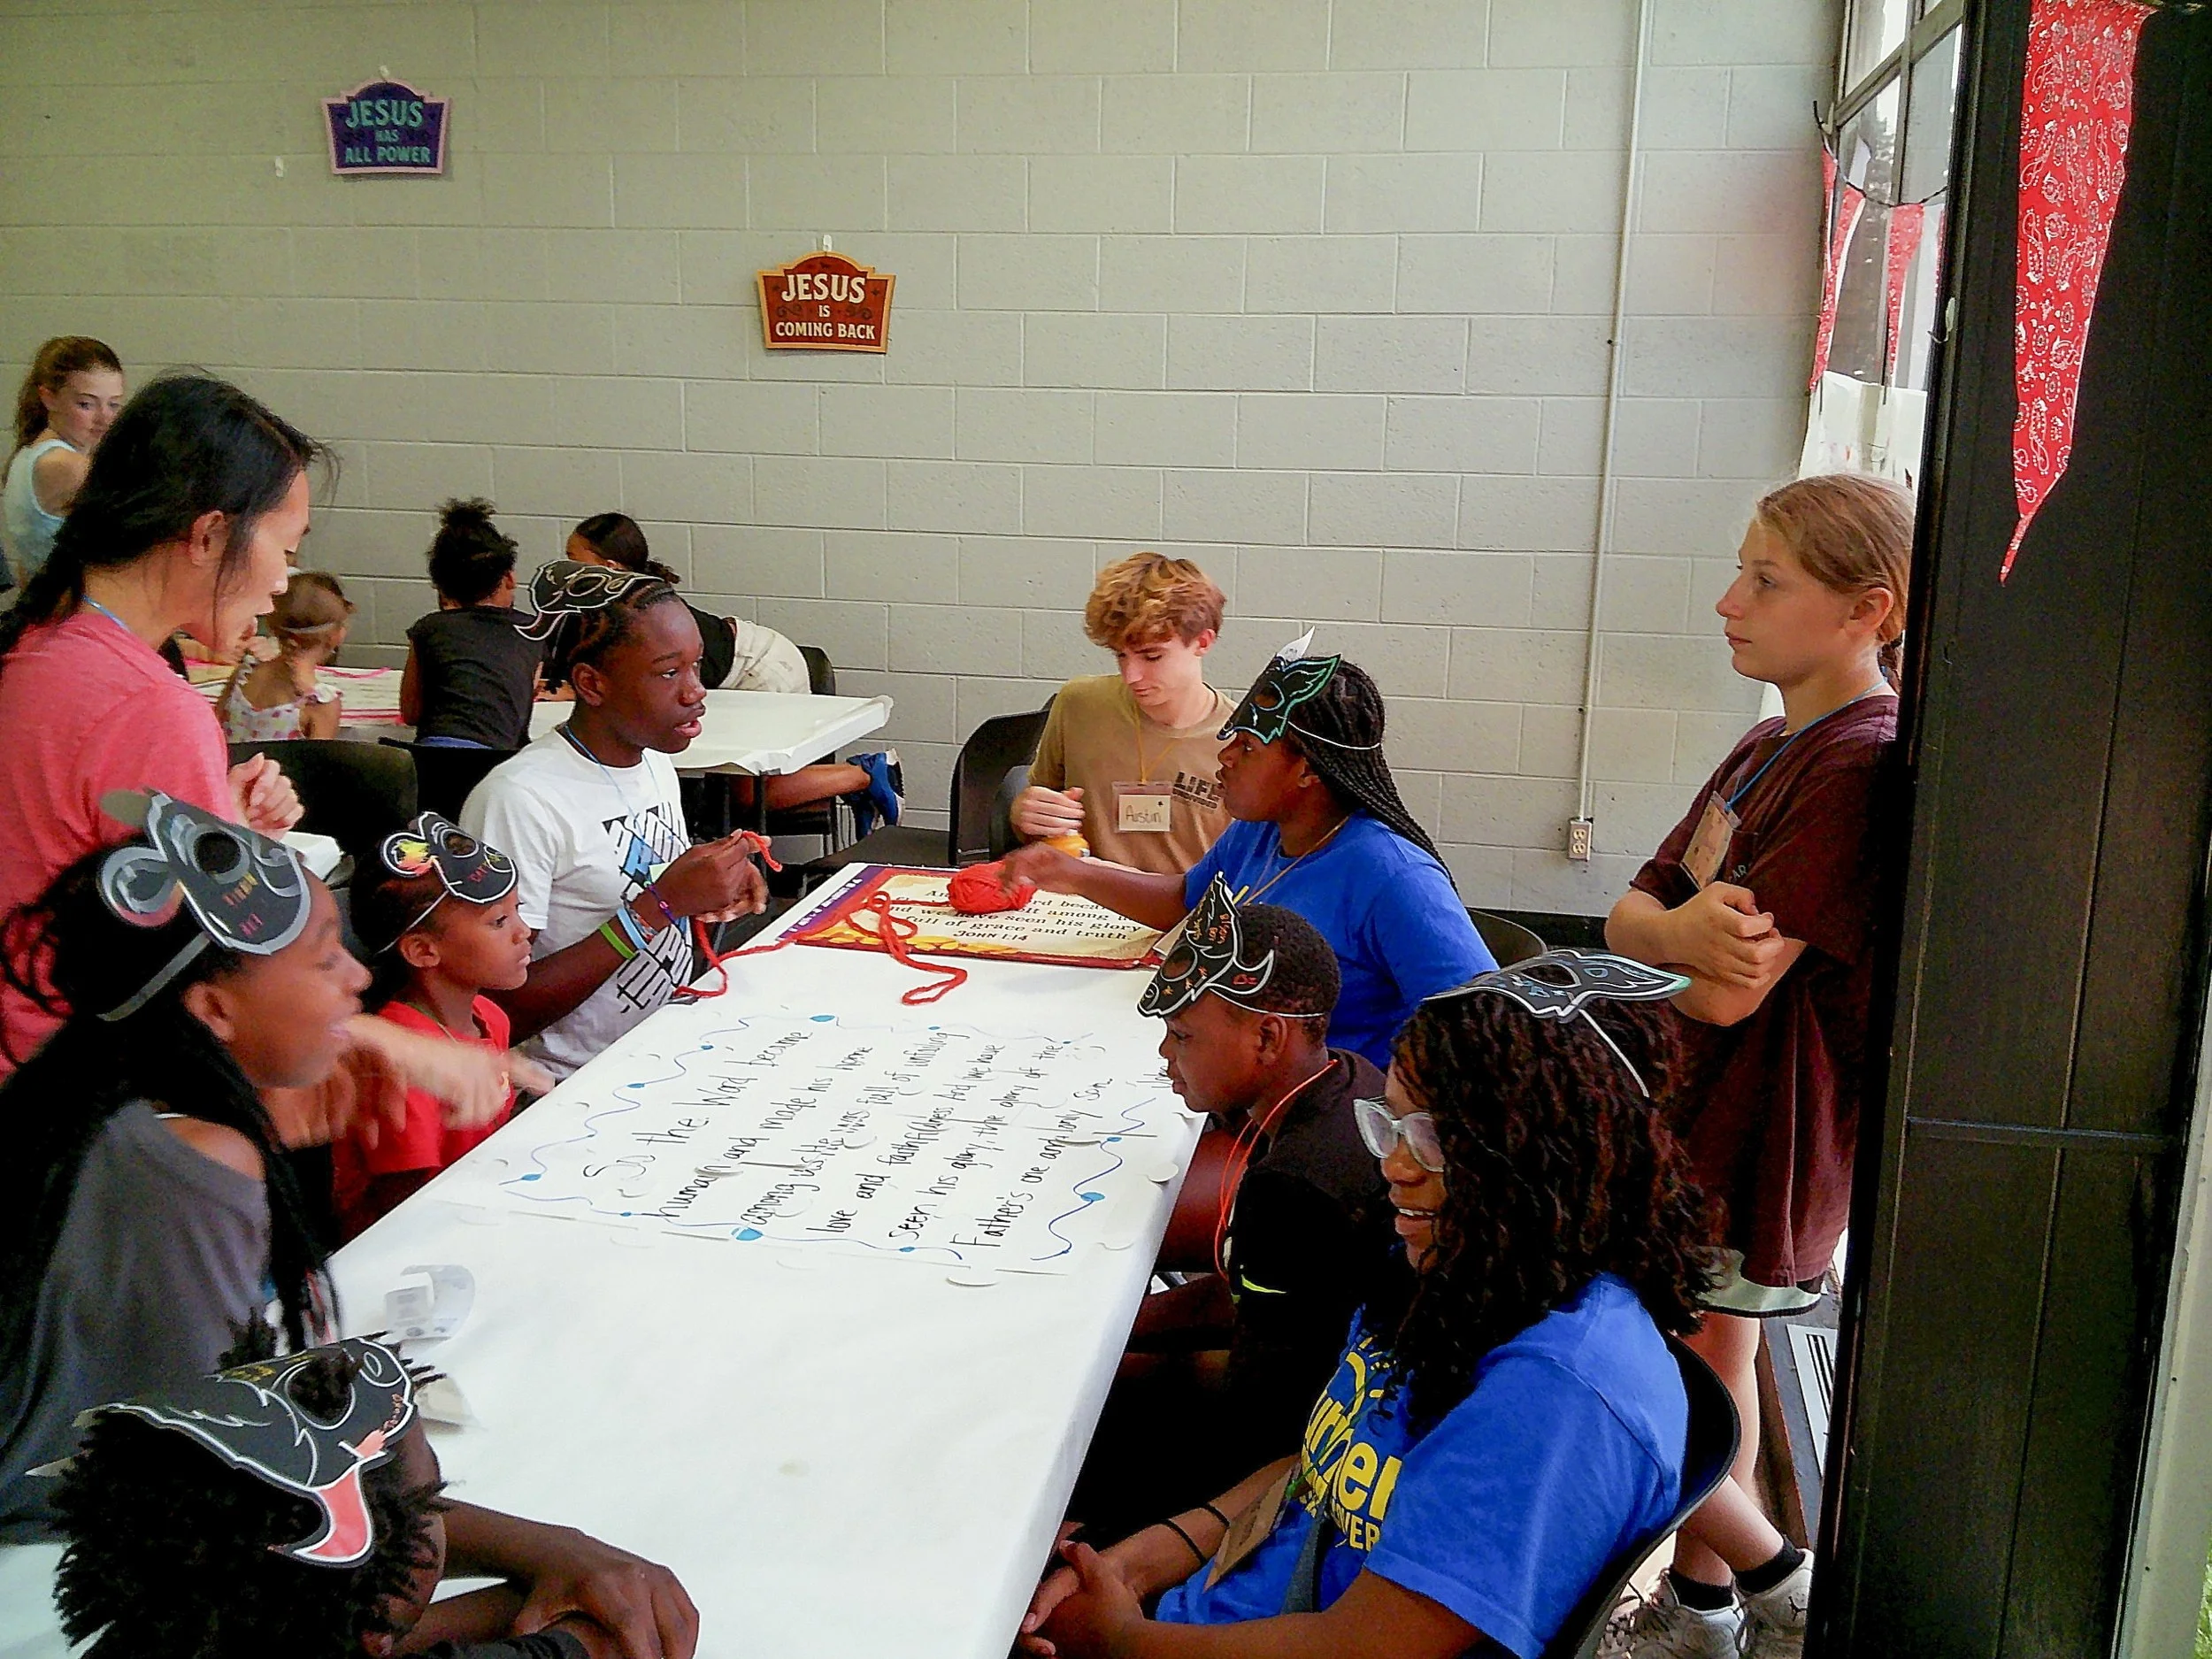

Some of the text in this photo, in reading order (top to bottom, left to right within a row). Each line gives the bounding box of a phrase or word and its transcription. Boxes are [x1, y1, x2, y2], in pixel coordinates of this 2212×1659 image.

[345, 99, 424, 128] JESUS
[374, 129, 399, 142] HAS
[345, 146, 431, 163] ALL POWER
[781, 273, 866, 303] JESUS
[818, 304, 831, 318] IS
[775, 321, 876, 340] COMING BACK
[1125, 804, 1162, 825] Austin
[1004, 914, 1047, 925] seen
[1055, 918, 1085, 927] his
[1089, 922, 1142, 933] glory
[1047, 910, 1110, 921] among
[906, 916, 940, 925] full
[970, 923, 1026, 932] grace
[1032, 927, 1068, 936] and
[953, 930, 999, 939] JOHN
[966, 1044, 1006, 1064] have
[962, 1067, 992, 1080] we
[933, 1083, 978, 1102] And
[632, 1118, 710, 1145] the
[672, 1075, 758, 1106] Word
[643, 1047, 873, 1217] human and made his home
[741, 1183, 821, 1225] among
[856, 1086, 900, 1105] full
[884, 1070, 921, 1083] of
[888, 1203, 939, 1240] seen
[915, 1175, 959, 1195] his
[972, 1115, 1007, 1137] the
[990, 1085, 1039, 1108] glory
[1018, 1066, 1041, 1079] of
[1032, 1045, 1064, 1060] the
[855, 1173, 892, 1199] and
[949, 1191, 1034, 1248] Father's
[1020, 1165, 1051, 1184] one
[1038, 1137, 1067, 1160] and
[805, 1210, 858, 1233] love
